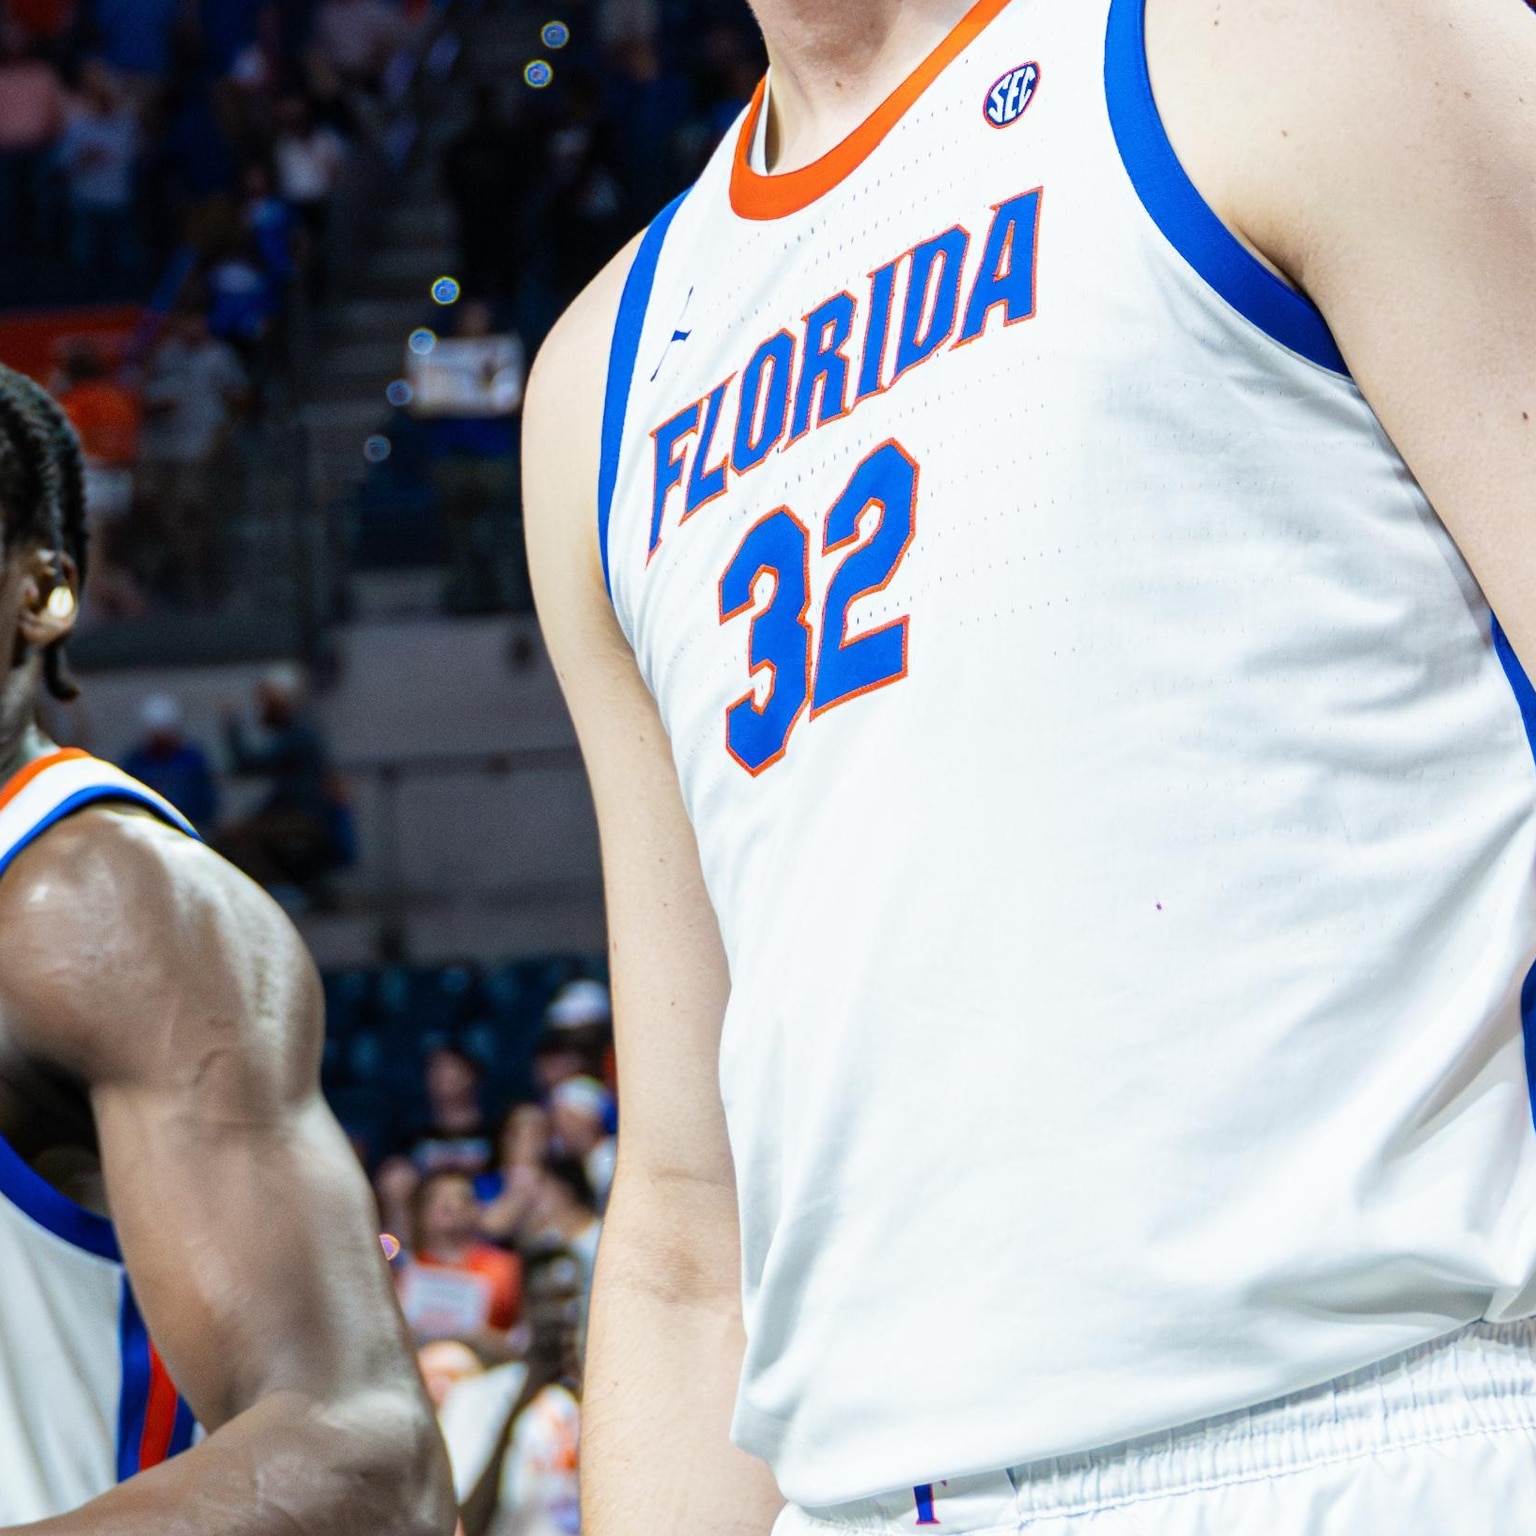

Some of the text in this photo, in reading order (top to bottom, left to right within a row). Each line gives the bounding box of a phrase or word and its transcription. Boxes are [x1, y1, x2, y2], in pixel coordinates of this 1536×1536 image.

[986, 64, 1037, 124] SEC
[645, 185, 1044, 568] FLORIDA
[717, 436, 921, 779] 32
